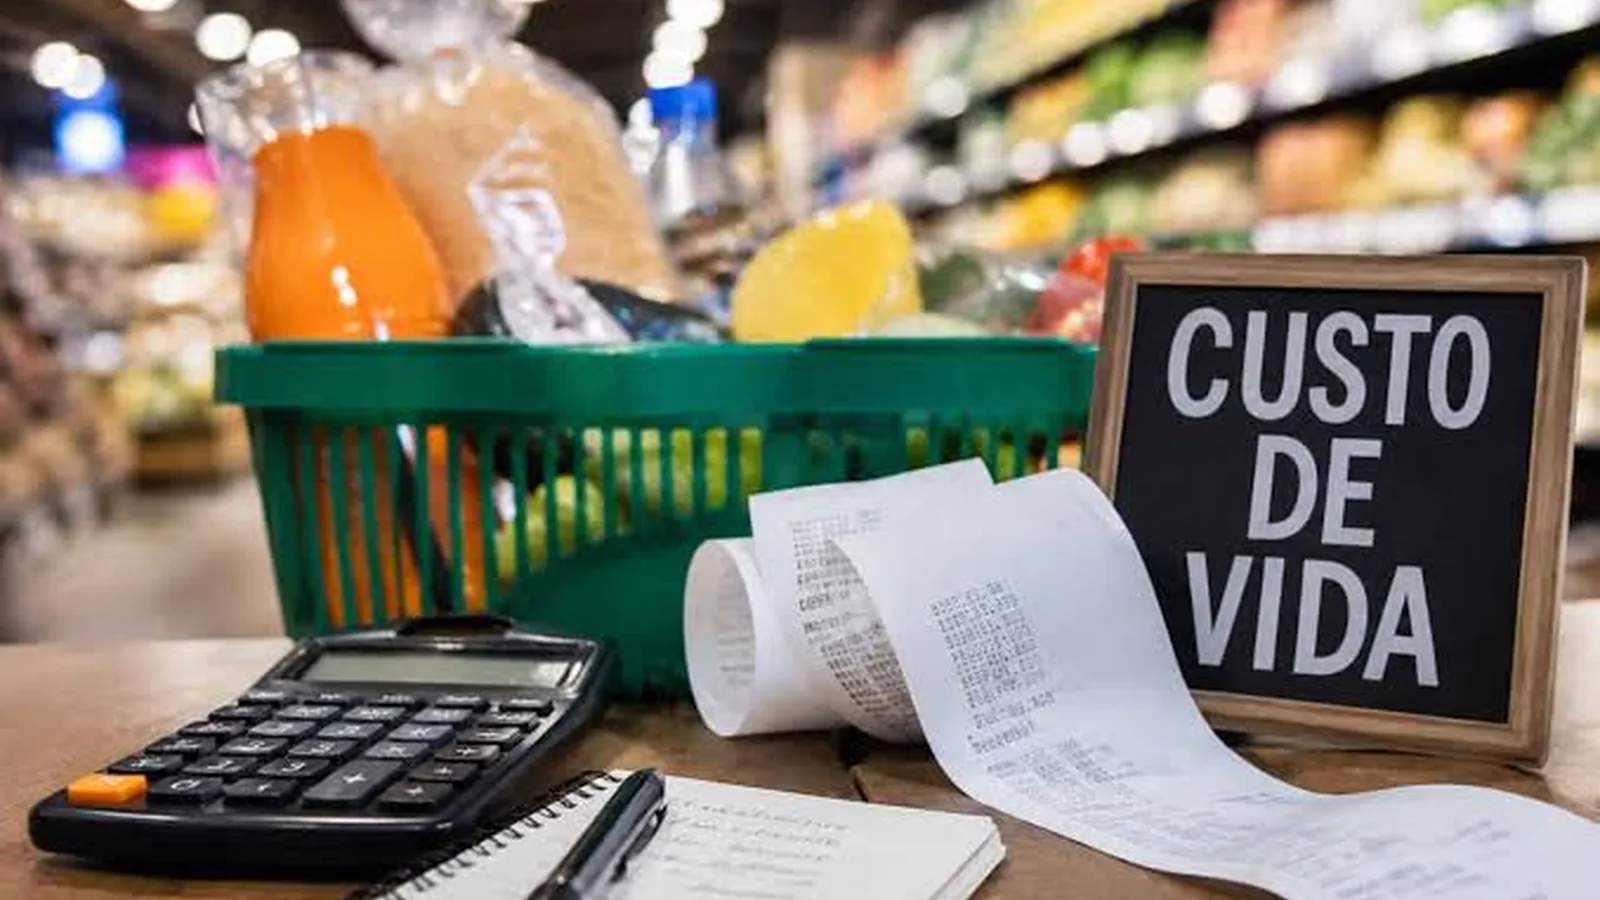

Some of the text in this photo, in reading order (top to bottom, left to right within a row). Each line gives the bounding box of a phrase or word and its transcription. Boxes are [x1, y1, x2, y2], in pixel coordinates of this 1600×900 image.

[1167, 307, 1491, 429] CUSTO
[1247, 435, 1383, 547] DE
[1186, 552, 1439, 687] VIDA
